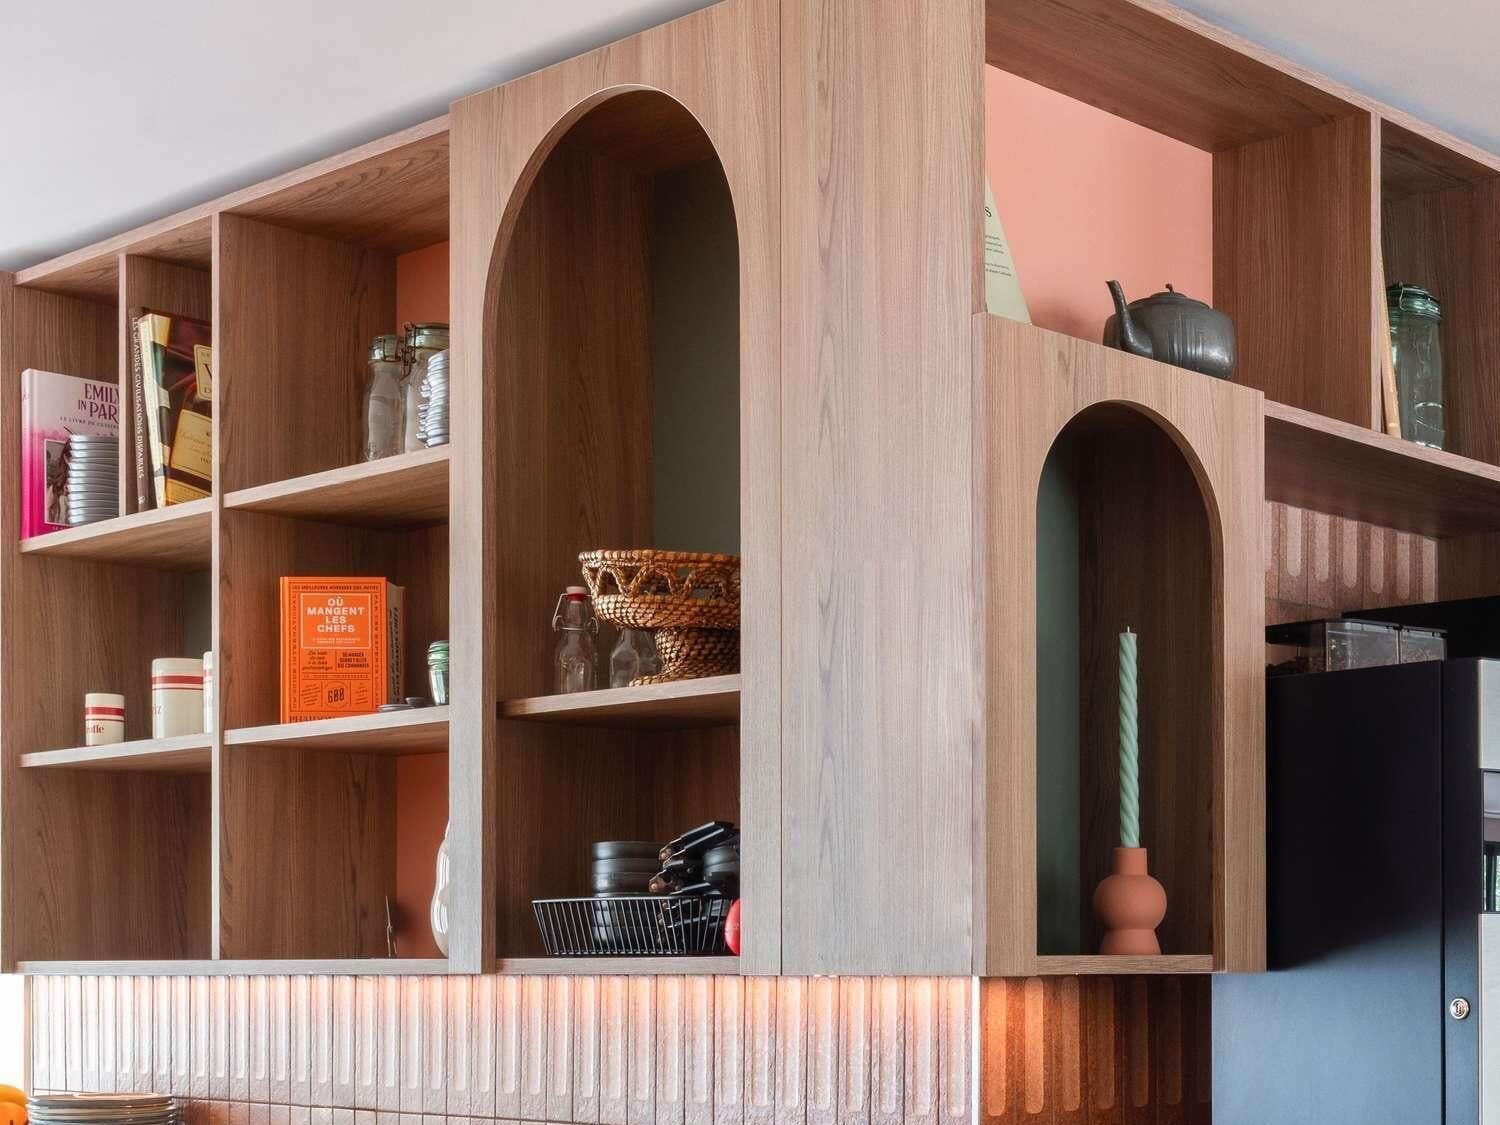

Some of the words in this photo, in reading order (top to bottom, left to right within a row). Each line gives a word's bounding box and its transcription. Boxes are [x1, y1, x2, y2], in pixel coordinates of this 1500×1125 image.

[78, 400, 87, 410] IN
[89, 401, 119, 424] PAR
[307, 607, 365, 616] MANGENT
[325, 616, 347, 624] LES
[317, 624, 355, 633] CHEFS
